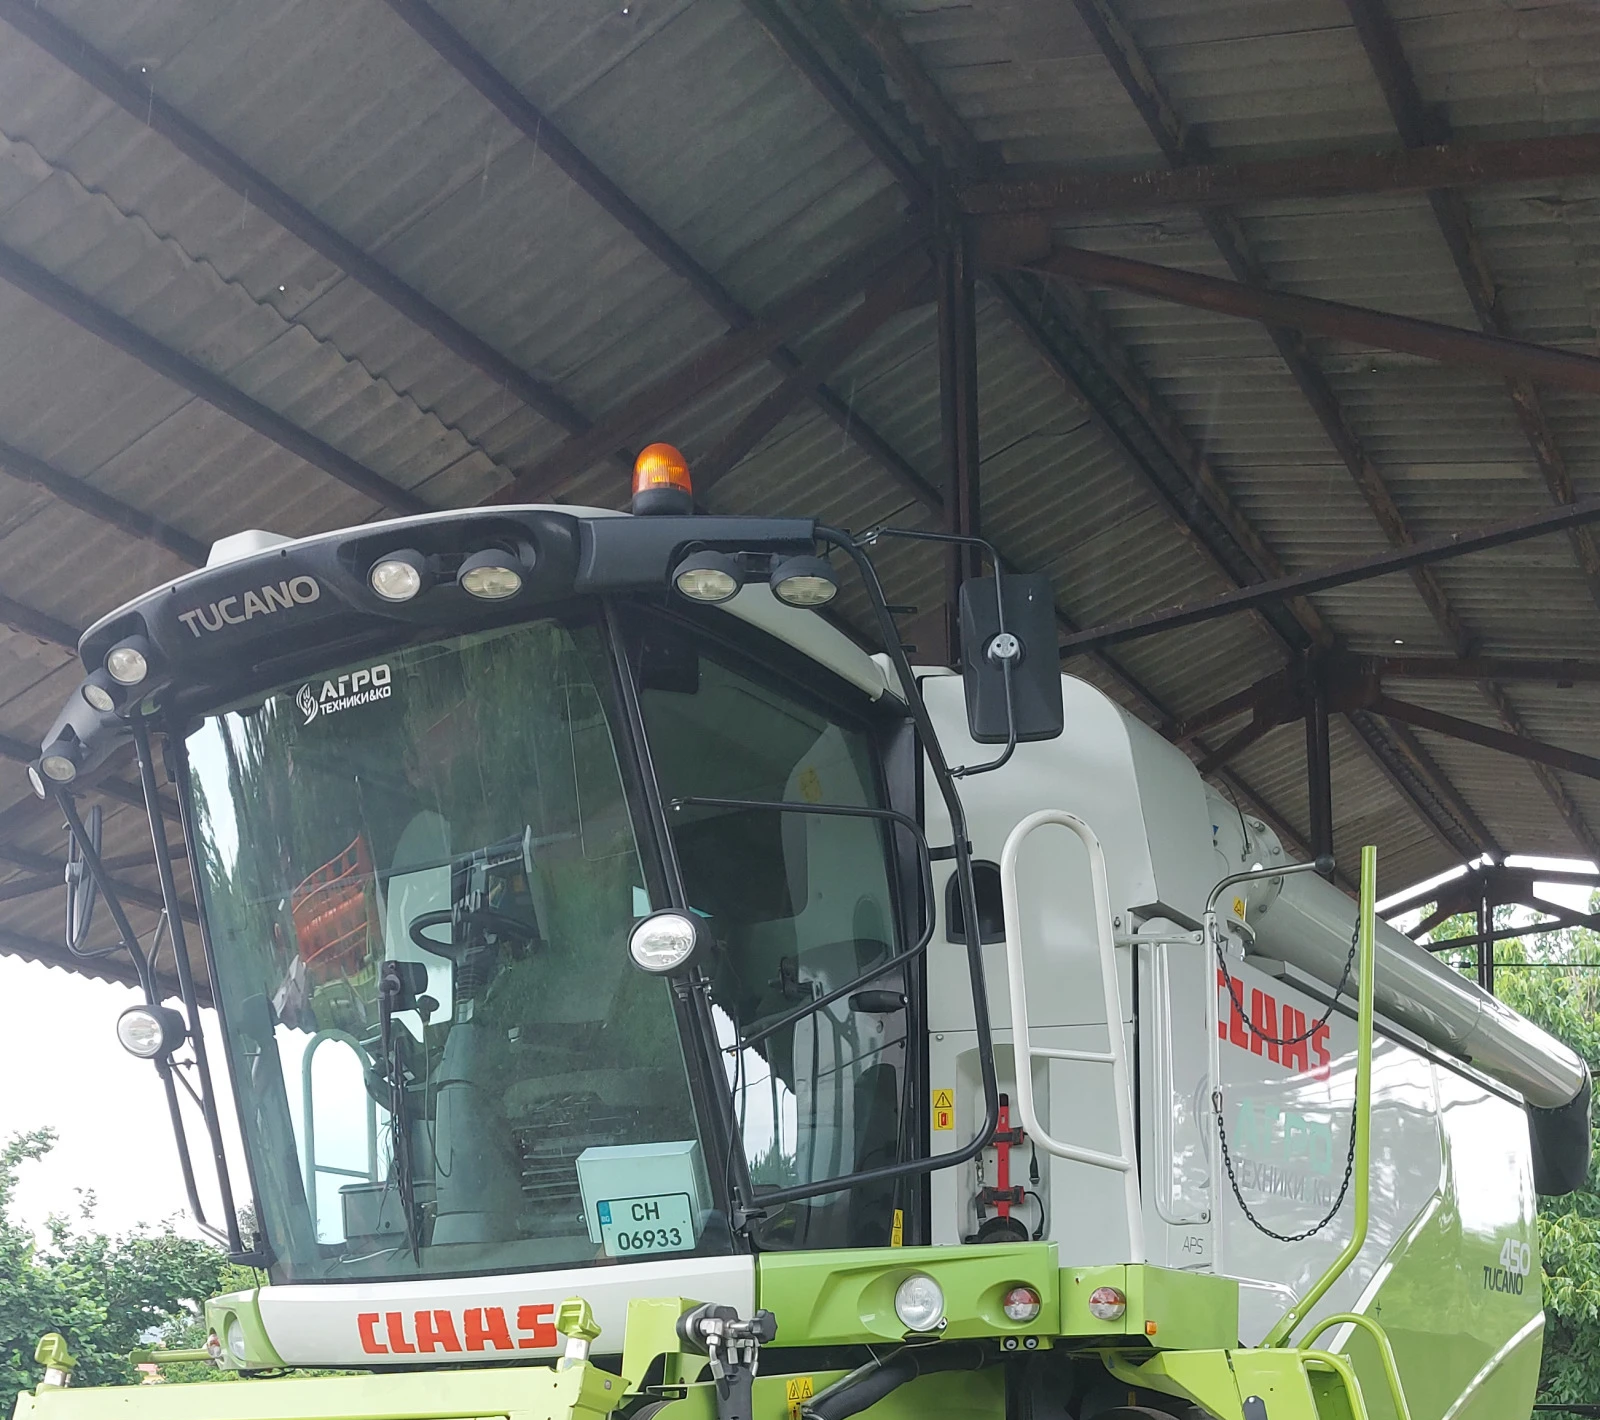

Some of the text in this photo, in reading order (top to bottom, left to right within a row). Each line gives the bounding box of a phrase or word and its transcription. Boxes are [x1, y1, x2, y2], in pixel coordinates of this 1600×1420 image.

[178, 575, 320, 637] TUCANO
[319, 664, 391, 702] АГРО
[320, 686, 391, 715] ТЕХНИКИ&КО
[631, 1201, 660, 1221] CH
[617, 1227, 682, 1250] 06933
[1182, 1236, 1204, 1255] APS
[1500, 1237, 1531, 1276] 450
[1483, 1265, 1524, 1296] TUCANO
[357, 1303, 558, 1355] CLAAS
